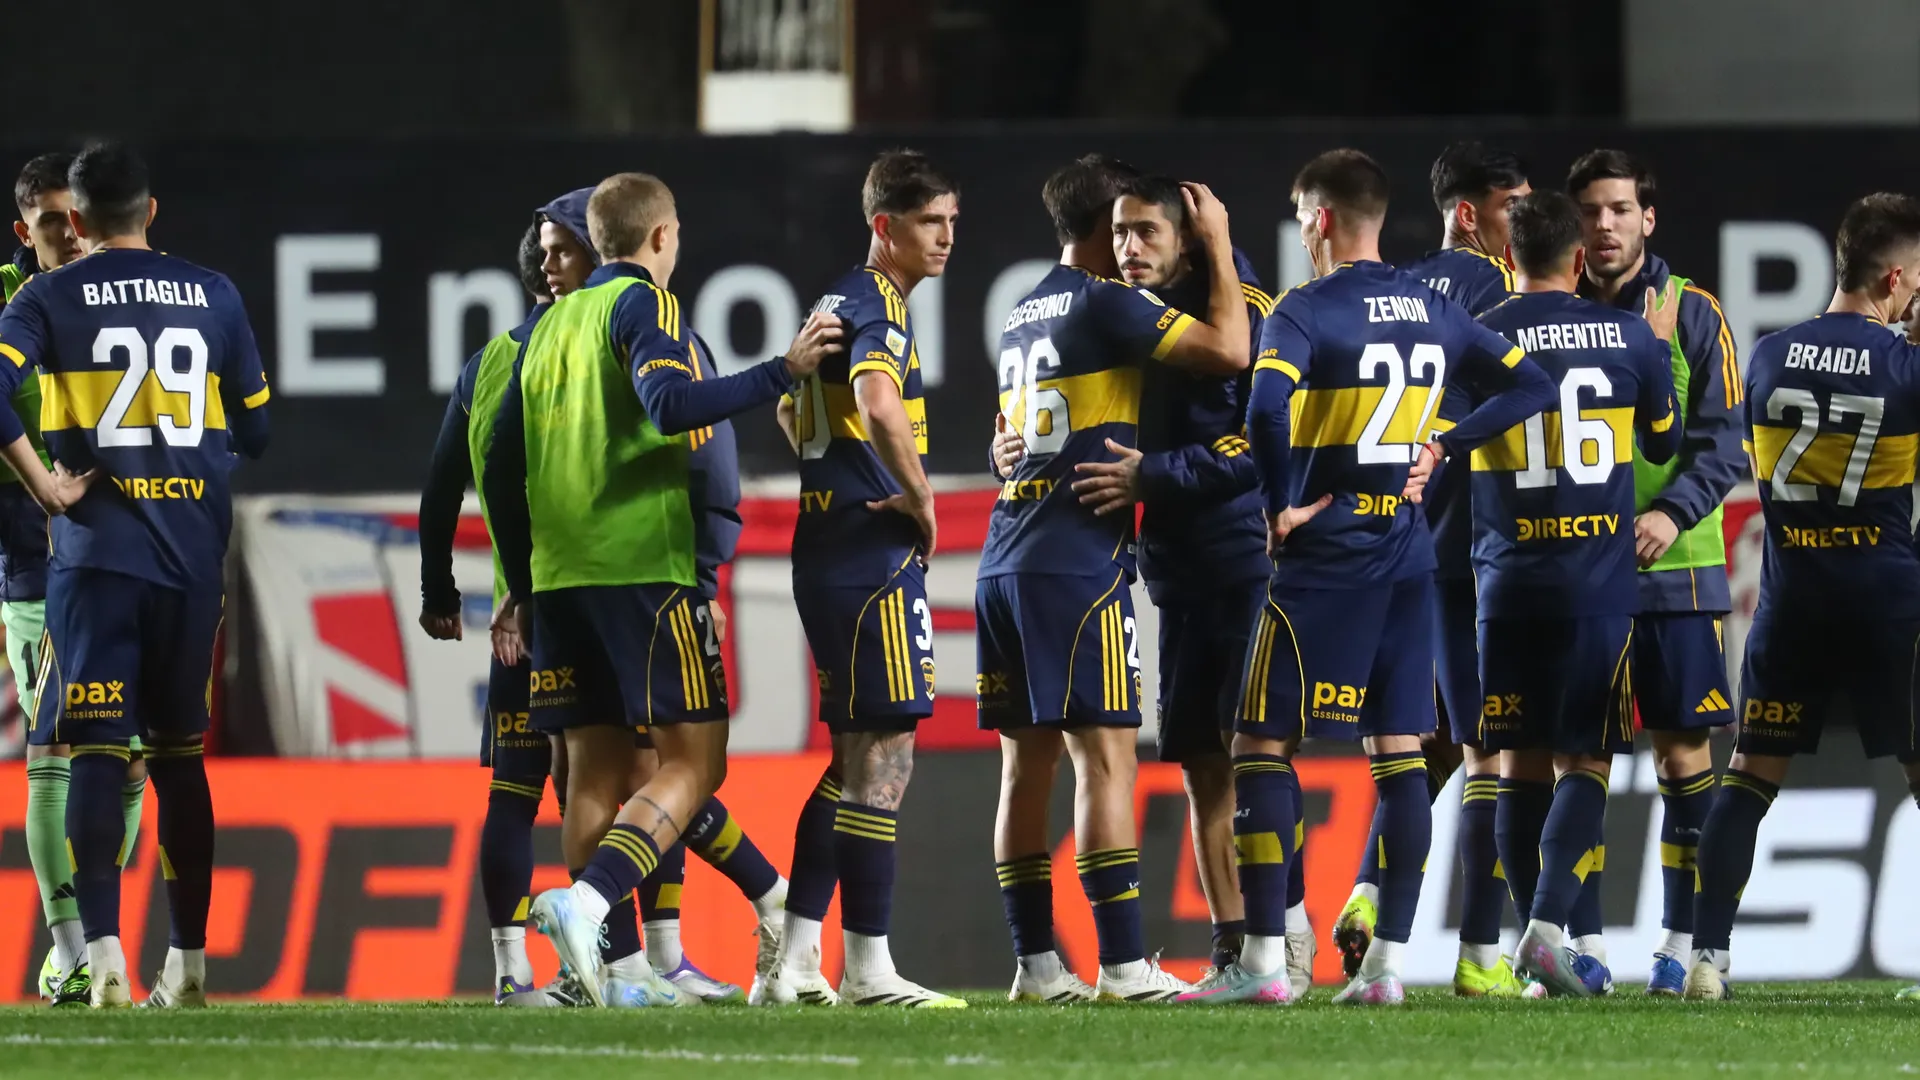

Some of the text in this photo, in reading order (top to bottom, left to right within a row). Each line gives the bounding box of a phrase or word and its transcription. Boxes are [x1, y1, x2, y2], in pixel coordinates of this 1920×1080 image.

[83, 278, 209, 309] BATTAGLIA
[1003, 291, 1074, 333] ELLEGRINO
[1363, 296, 1430, 323] ZENON
[1516, 322, 1628, 353] MERENTIEL
[637, 358, 694, 378] CETROGA
[1784, 342, 1871, 376] BRAIDA
[92, 327, 209, 448] 29
[1766, 386, 1885, 508] 27
[1515, 513, 1620, 541] DIRECTV
[65, 680, 124, 710] pax
[65, 709, 123, 719] assistance
[1312, 709, 1360, 723] assistan
[1743, 697, 1804, 725] pax
